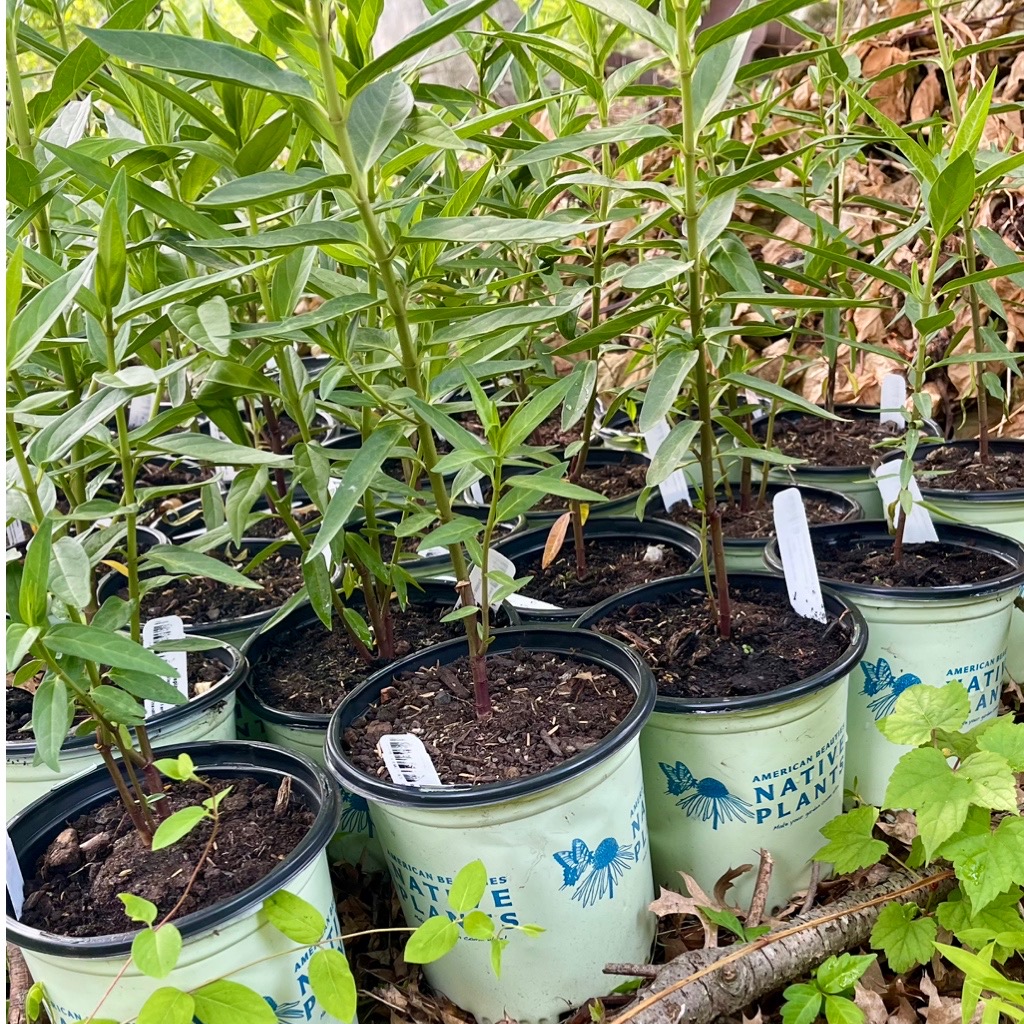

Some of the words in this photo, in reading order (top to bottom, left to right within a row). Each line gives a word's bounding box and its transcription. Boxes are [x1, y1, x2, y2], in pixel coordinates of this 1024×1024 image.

[946, 658, 994, 676] AMERICAN
[752, 755, 813, 783] AMERICAN
[753, 734, 844, 804] NATIVE
[391, 860, 513, 908] NATE
[436, 874, 508, 886] BEES
